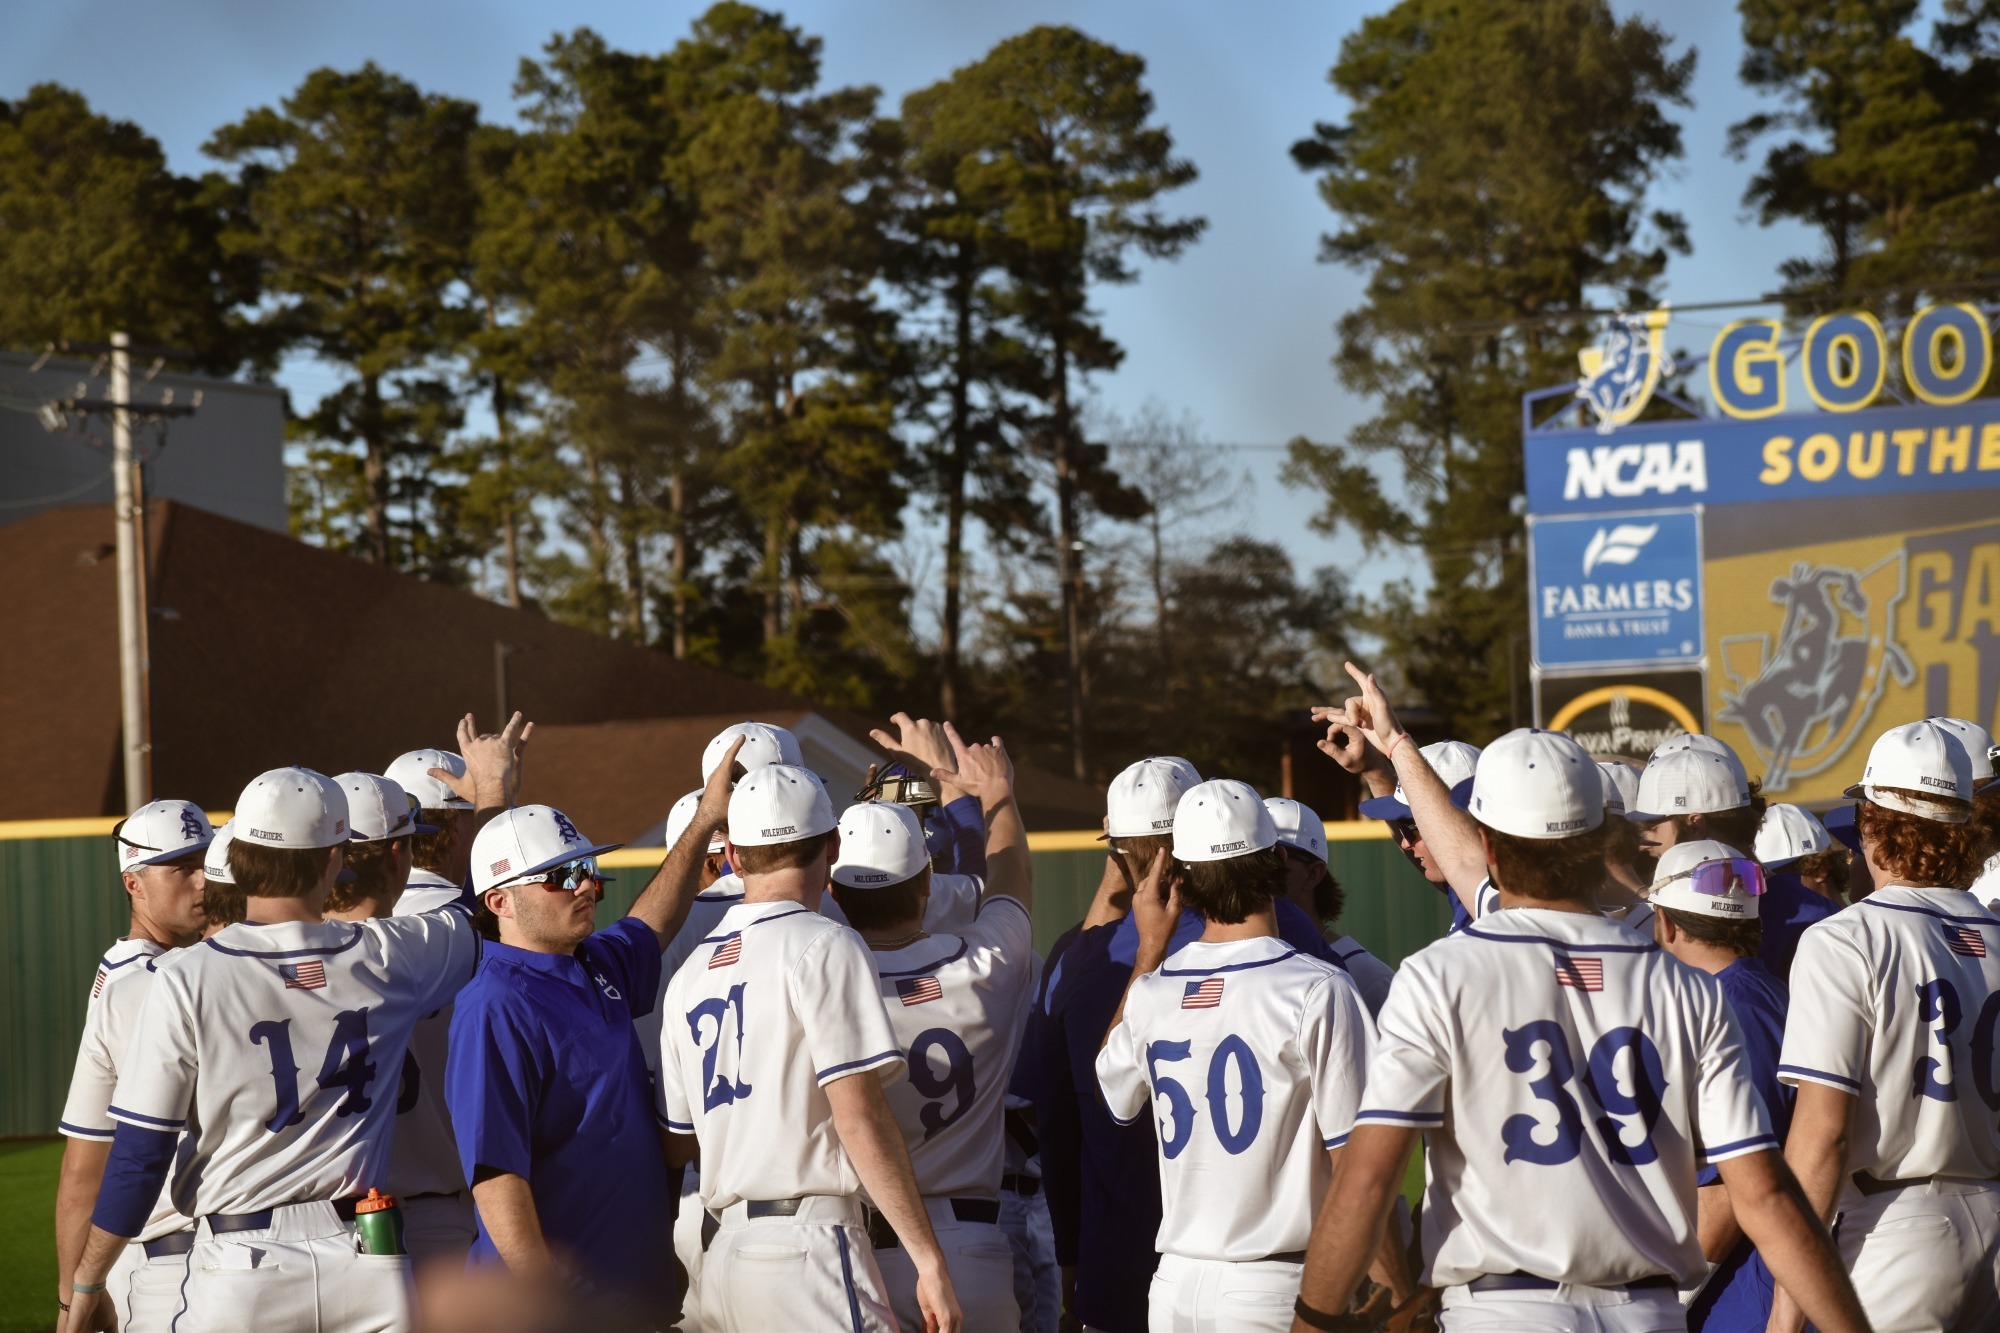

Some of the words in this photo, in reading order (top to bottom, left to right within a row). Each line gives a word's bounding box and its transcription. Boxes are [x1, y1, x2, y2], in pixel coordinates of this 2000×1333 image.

[1709, 302, 1992, 420] GOO
[1564, 440, 1707, 500] NCAA
[1543, 578, 1693, 618] FARMERS
[1623, 618, 1670, 635] TRUST
[249, 1006, 377, 1134] 14
[686, 981, 752, 1115] 21
[908, 1027, 976, 1142] 9
[1146, 1034, 1266, 1160] 50
[1501, 1019, 1670, 1166] 39
